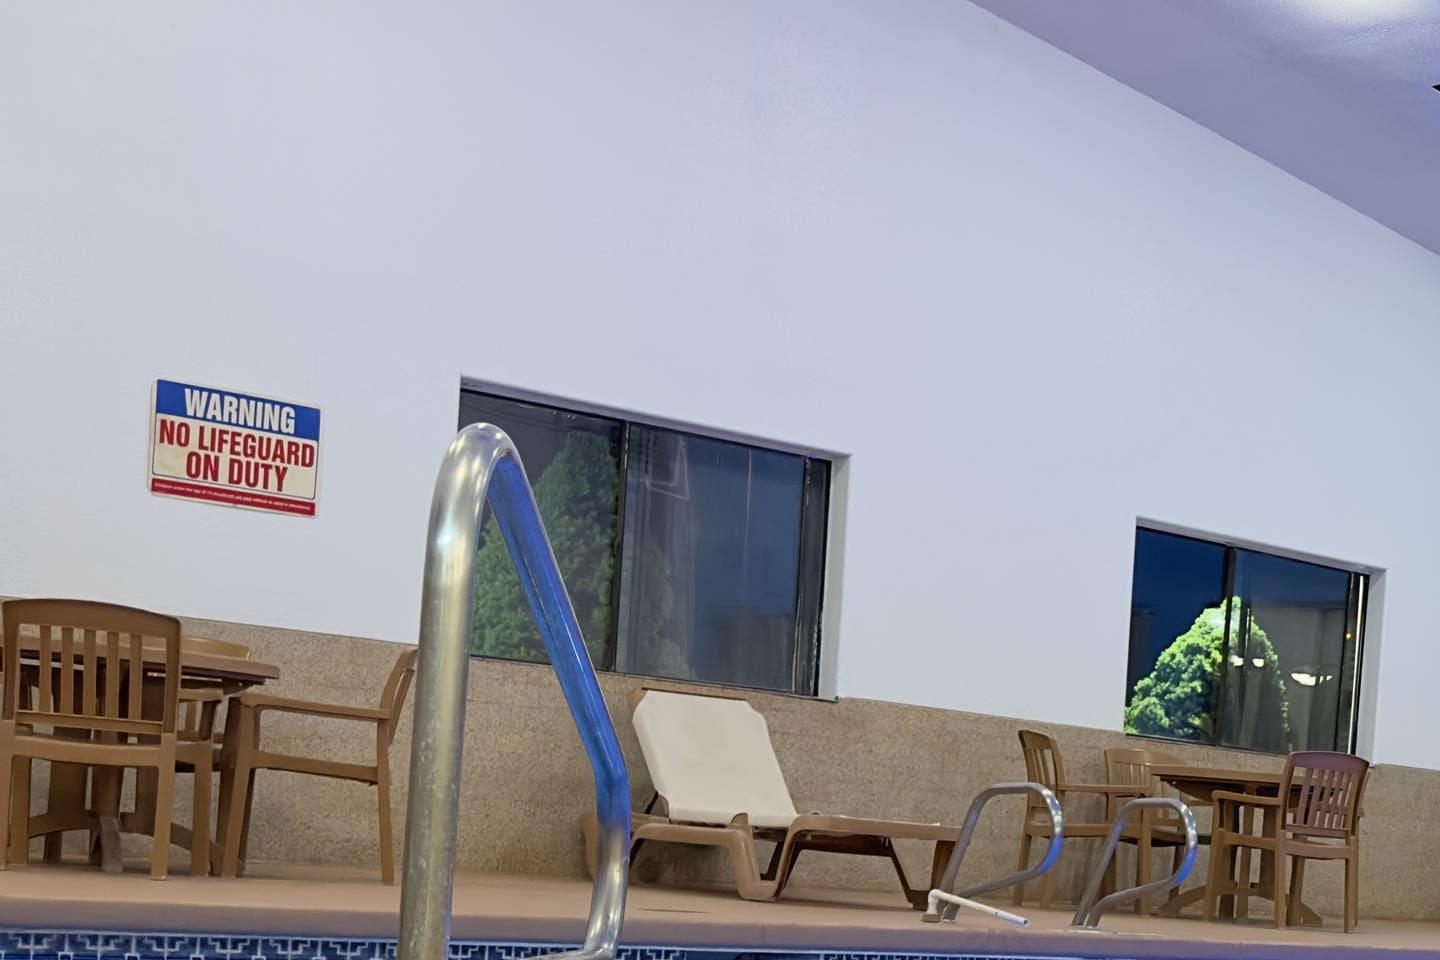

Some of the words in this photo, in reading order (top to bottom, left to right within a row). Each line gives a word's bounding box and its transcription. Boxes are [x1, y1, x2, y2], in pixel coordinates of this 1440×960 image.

[185, 388, 295, 434] WARNING
[159, 419, 190, 447] NO
[198, 426, 314, 468] LIFEGUARD
[186, 451, 219, 482] ON
[228, 458, 288, 492] DUTY
